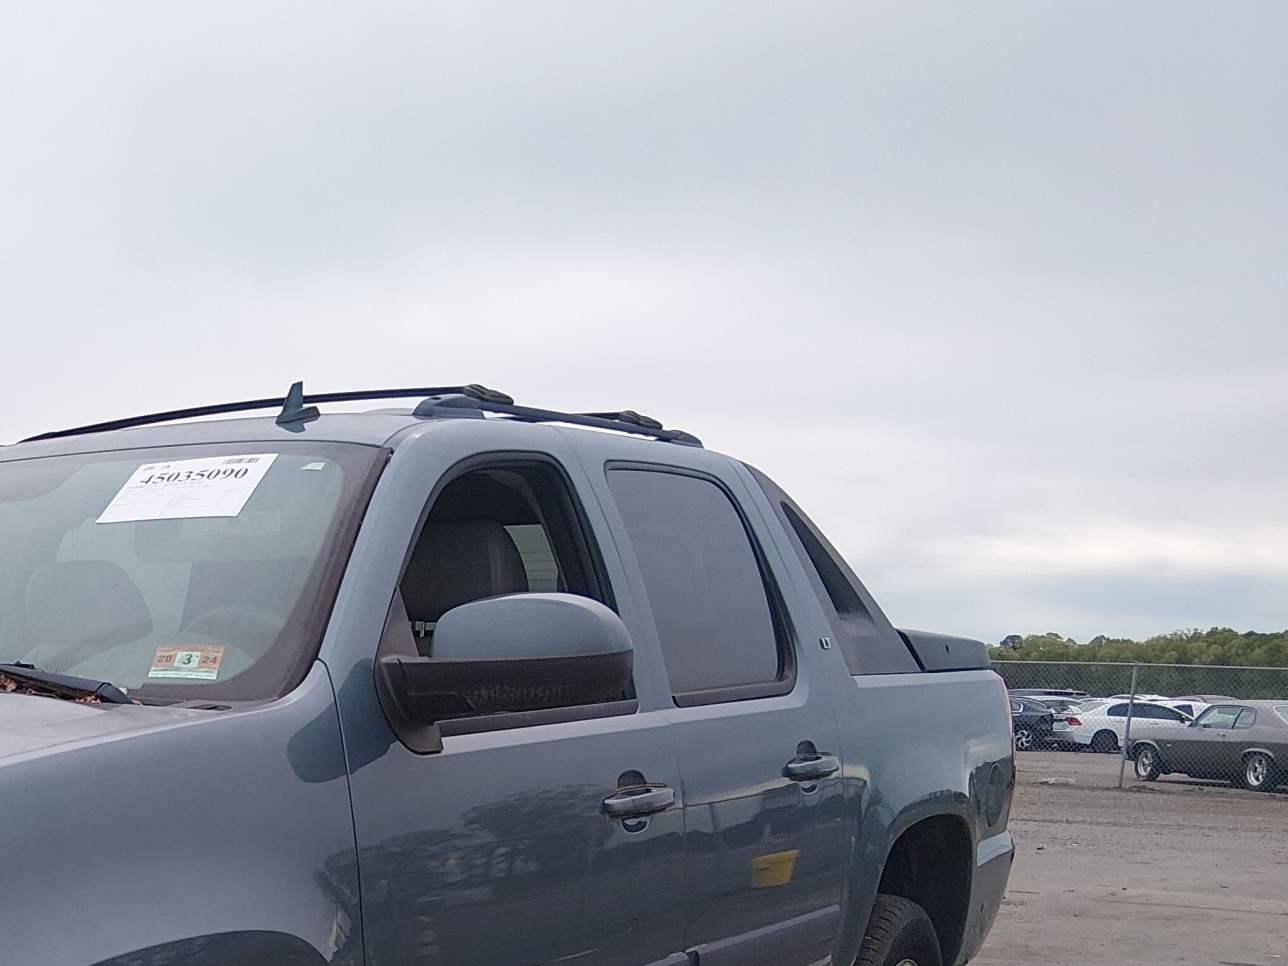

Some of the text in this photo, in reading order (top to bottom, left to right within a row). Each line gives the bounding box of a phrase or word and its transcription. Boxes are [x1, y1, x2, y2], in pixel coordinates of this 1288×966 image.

[140, 467, 249, 485] 45035090
[182, 653, 193, 666] 3
[200, 655, 218, 666] 24
